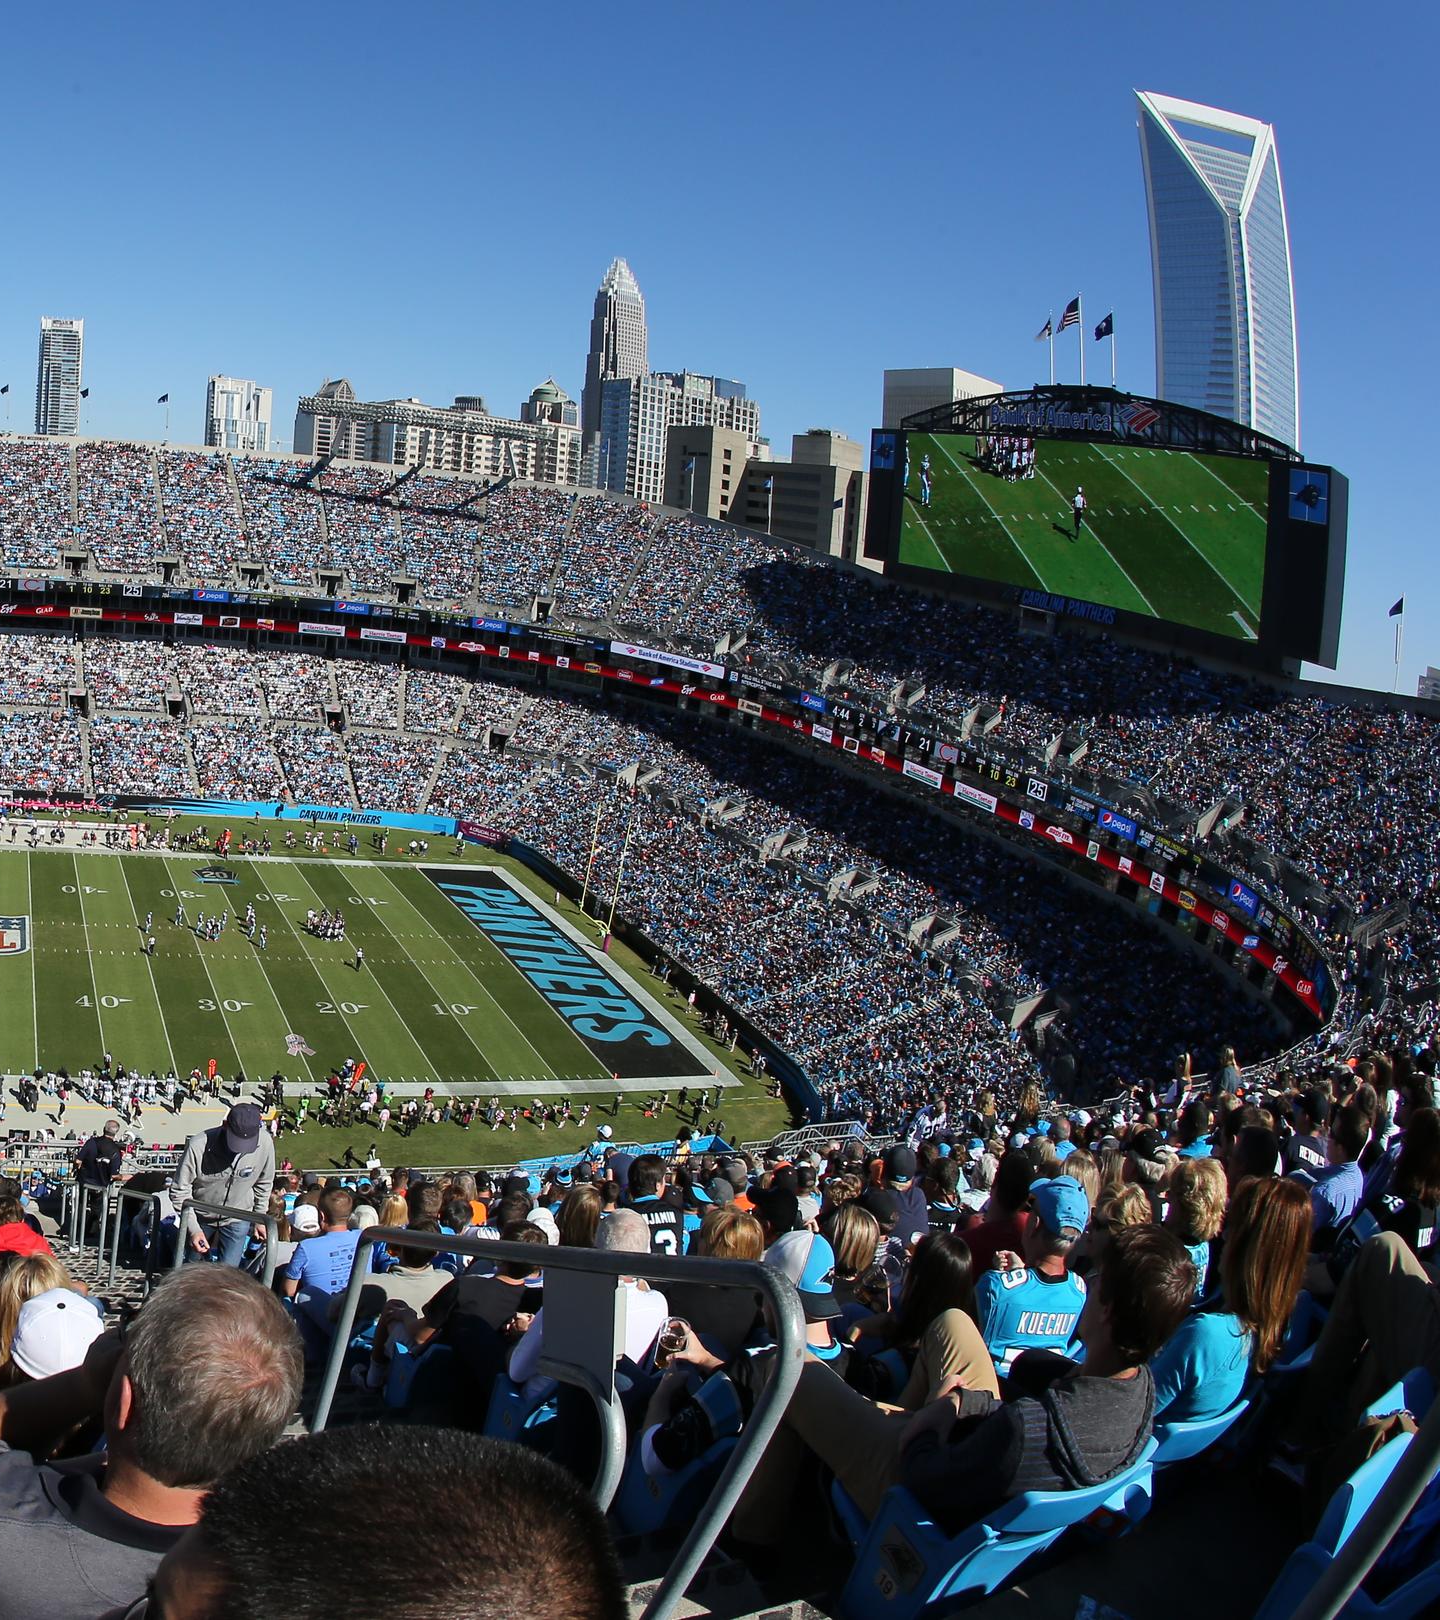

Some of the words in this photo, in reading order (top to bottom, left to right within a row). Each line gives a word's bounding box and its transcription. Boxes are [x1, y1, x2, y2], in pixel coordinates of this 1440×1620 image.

[990, 403, 1029, 427] Bank
[1027, 405, 1048, 427] of
[1047, 404, 1113, 432] America
[0, 579, 12, 589] 21
[82, 586, 93, 594] 10
[127, 586, 140, 595] 25
[100, 587, 111, 595] 23
[206, 592, 224, 601] pepsi
[35, 606, 53, 614] GLAD
[346, 604, 365, 613] pepsi
[1023, 590, 1066, 613] CAROLINA
[1067, 598, 1117, 625] PANTHERS
[485, 621, 502, 630] pepsi
[638, 649, 651, 658] Bank
[651, 651, 658, 659] of
[658, 652, 679, 664] America
[679, 658, 700, 669] Stadium
[710, 693, 725, 701] GLAD
[832, 705, 849, 720] 4:44
[858, 718, 863, 727] 2
[904, 731, 911, 743] 7
[919, 737, 930, 752] 21
[990, 769, 1000, 781] 10
[1005, 775, 1016, 788] 23
[1030, 781, 1044, 798] 25
[299, 809, 338, 821] CAROLINA
[341, 812, 382, 825] PANTHERS
[1111, 820, 1132, 835] pepsi
[202, 870, 228, 879] 20
[438, 882, 672, 1047] PANTHERS
[1296, 980, 1312, 995] GLAD
[75, 994, 120, 1008] 40
[198, 998, 243, 1013] 30
[315, 1001, 359, 1015] 20
[432, 1003, 469, 1016] 10
[1016, 1310, 1077, 1336] KUECHLY
